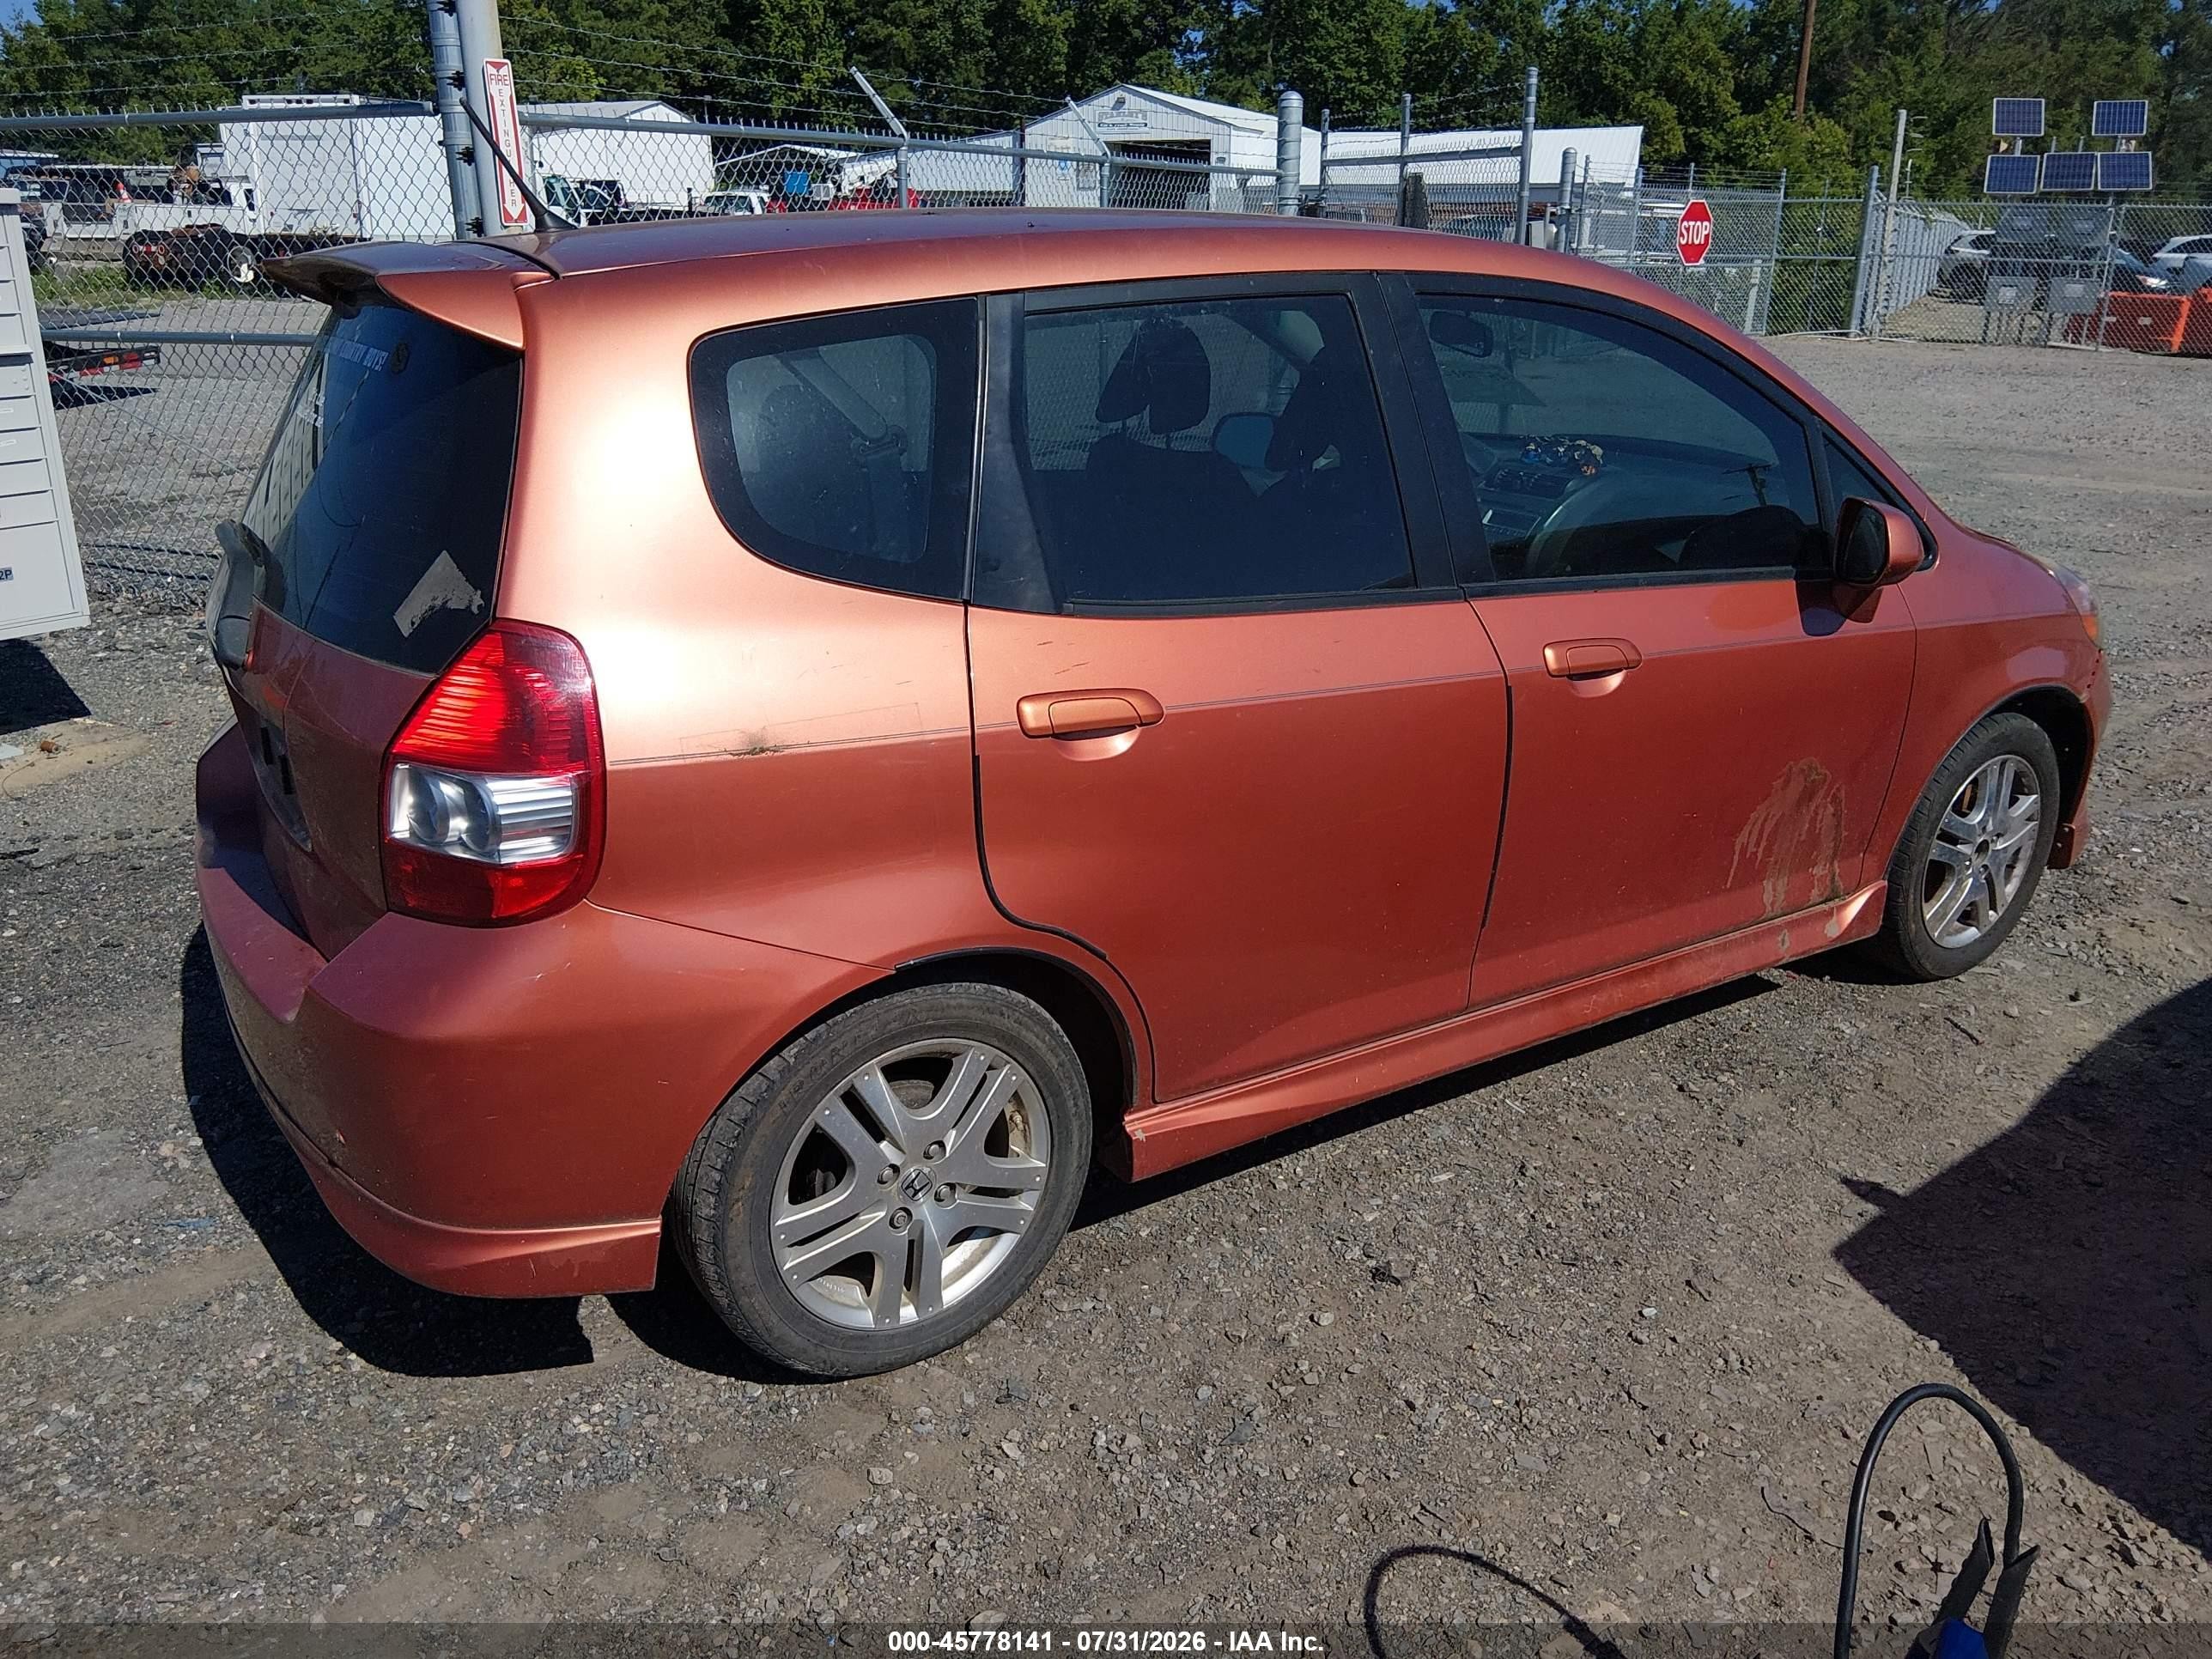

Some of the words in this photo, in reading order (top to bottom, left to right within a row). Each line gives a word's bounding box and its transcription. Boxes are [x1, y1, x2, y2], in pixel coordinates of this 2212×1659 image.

[489, 74, 509, 86] FIRE
[498, 88, 517, 207] EXTINGUHER
[1680, 221, 1710, 245] STOP
